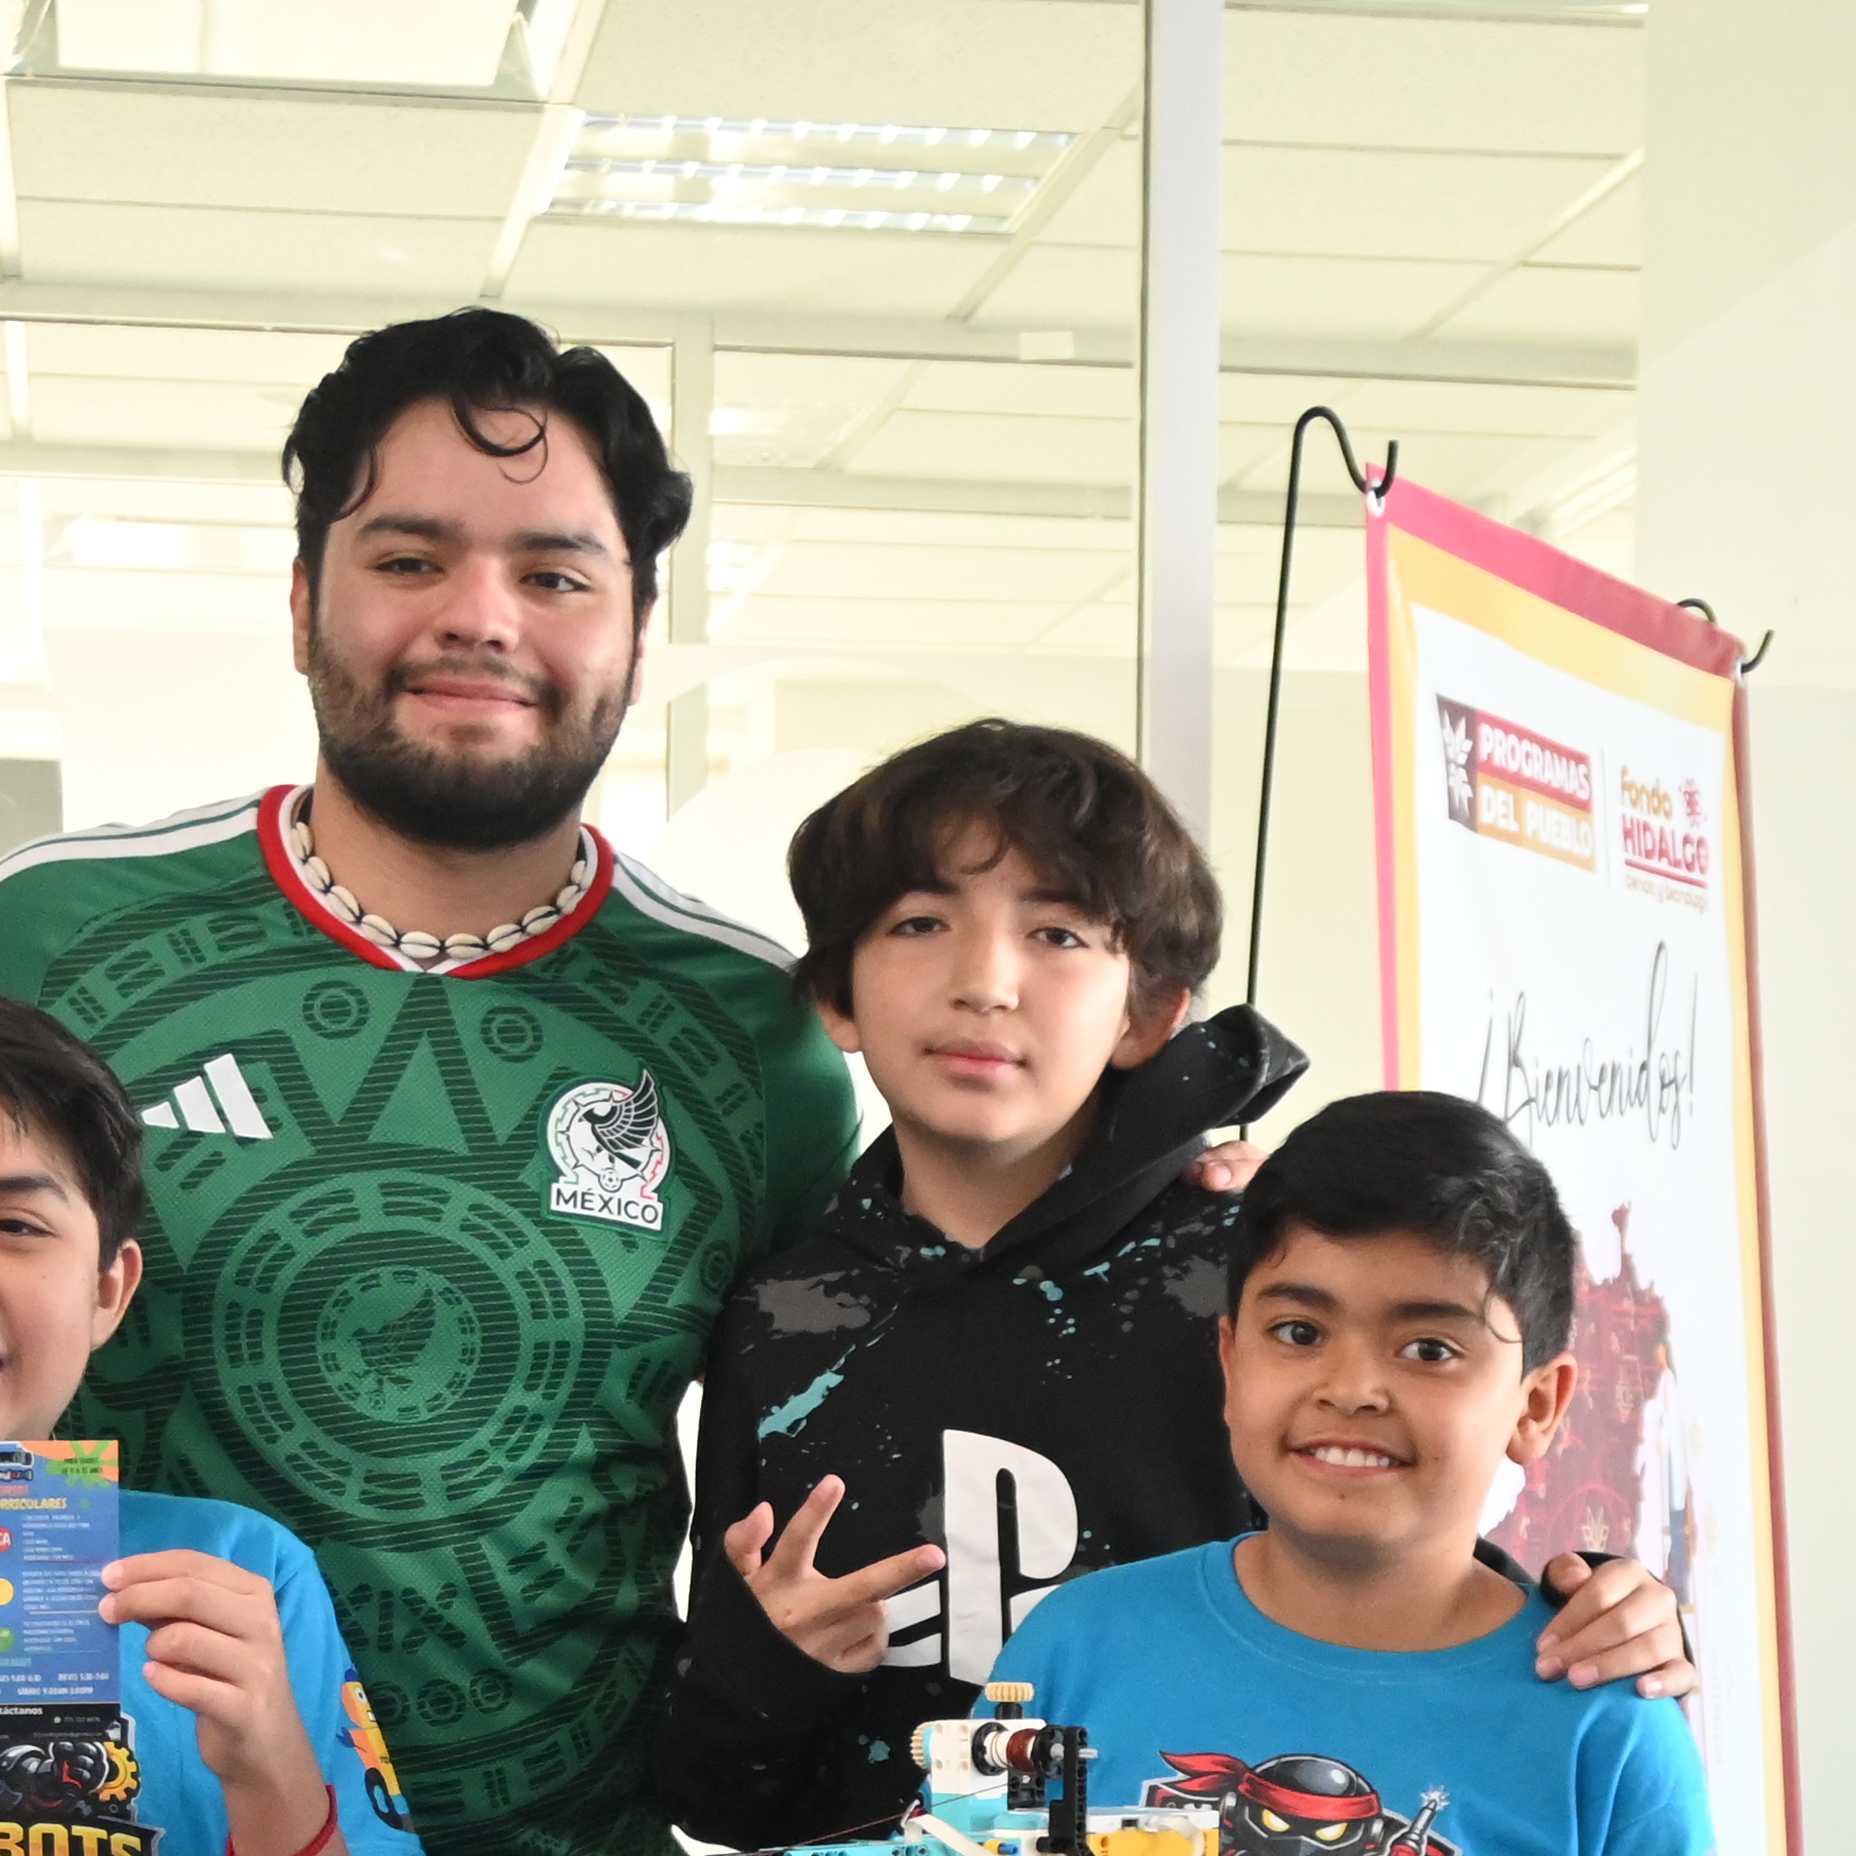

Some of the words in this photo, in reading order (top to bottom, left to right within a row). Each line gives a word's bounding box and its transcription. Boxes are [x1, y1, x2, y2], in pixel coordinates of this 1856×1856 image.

[1480, 722, 1591, 801] PROGRAMAS
[1482, 784, 1520, 833] DEL
[1526, 800, 1594, 860] PUEBLO
[1622, 812, 1709, 876] HIDALGO
[554, 1188, 662, 1229] MÉXICO
